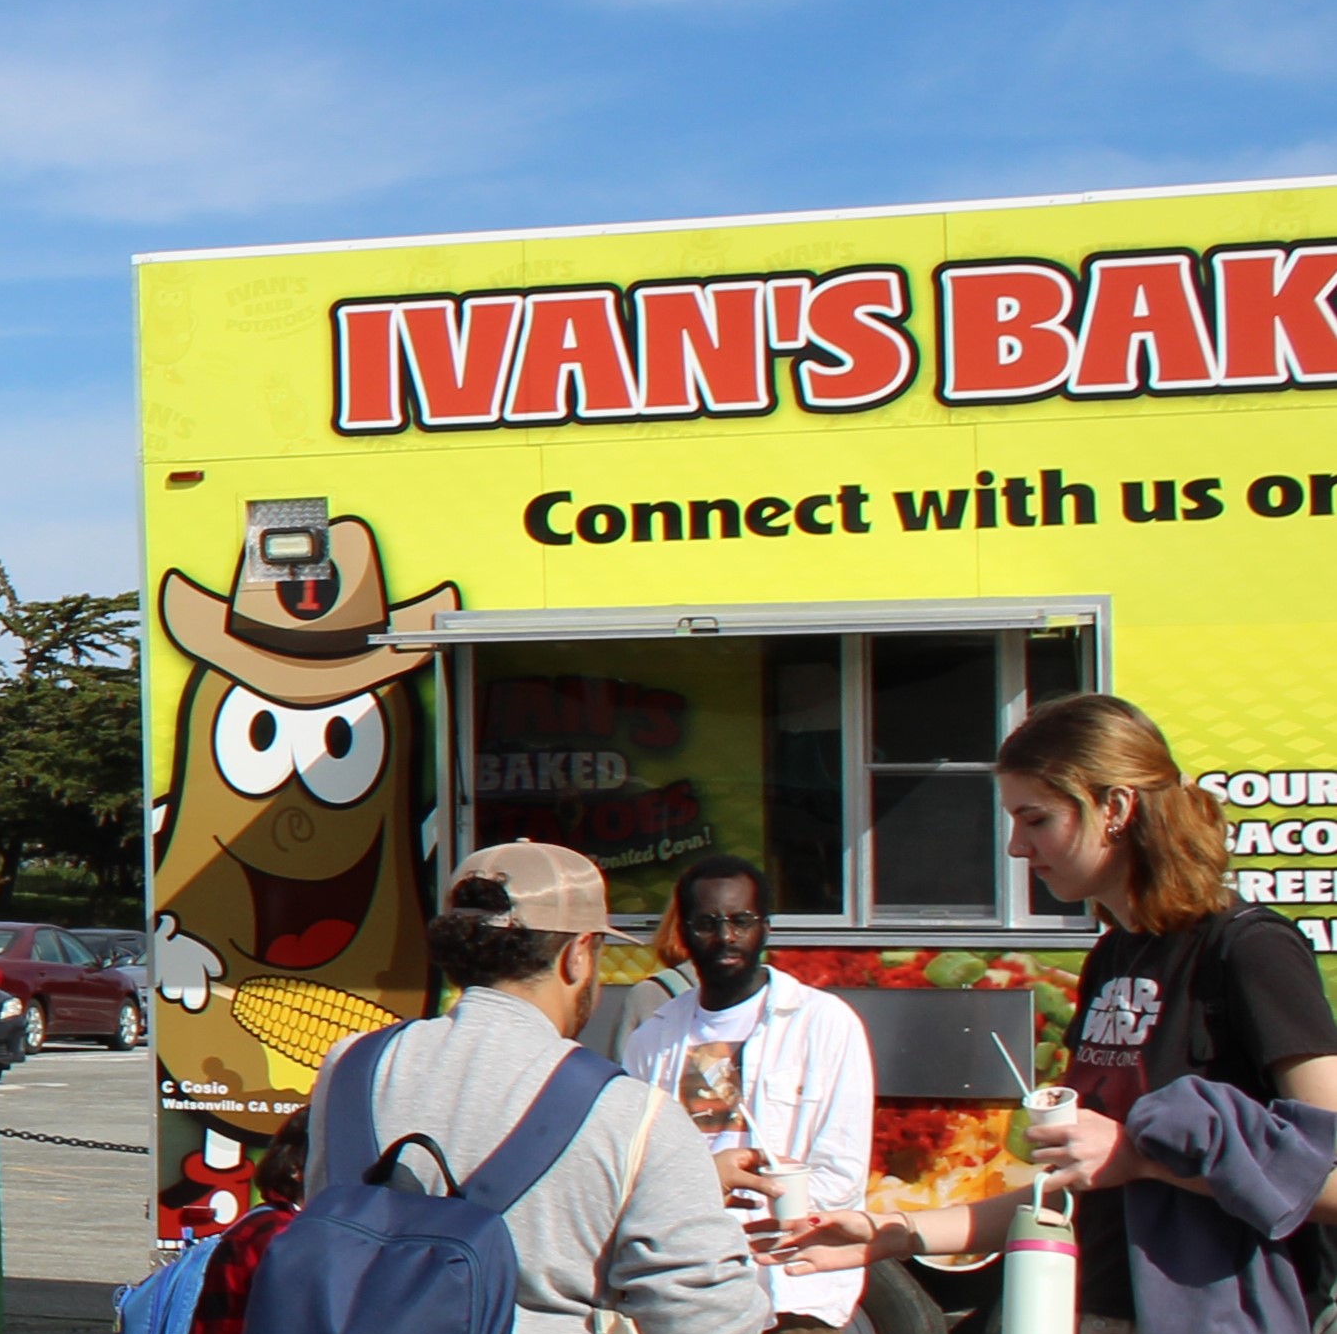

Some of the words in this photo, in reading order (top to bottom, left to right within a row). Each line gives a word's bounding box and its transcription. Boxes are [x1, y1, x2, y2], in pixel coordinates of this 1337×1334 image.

[227, 275, 311, 307] IVAN'S
[332, 265, 918, 435] IVAN'S
[934, 239, 1337, 406] BAK
[525, 484, 871, 546] Connect
[893, 469, 1098, 532] with
[1121, 477, 1225, 523] us
[476, 677, 686, 749] AN'S
[476, 751, 626, 791] BAKED
[592, 843, 655, 869] oasted
[657, 825, 713, 861] Corn!
[1223, 870, 1337, 903] REE
[161, 1080, 174, 1094] C
[180, 1080, 228, 1095] Cosio
[162, 1098, 244, 1112] Watsonville
[247, 1100, 269, 1113] CA
[273, 1102, 306, 1115] 950
